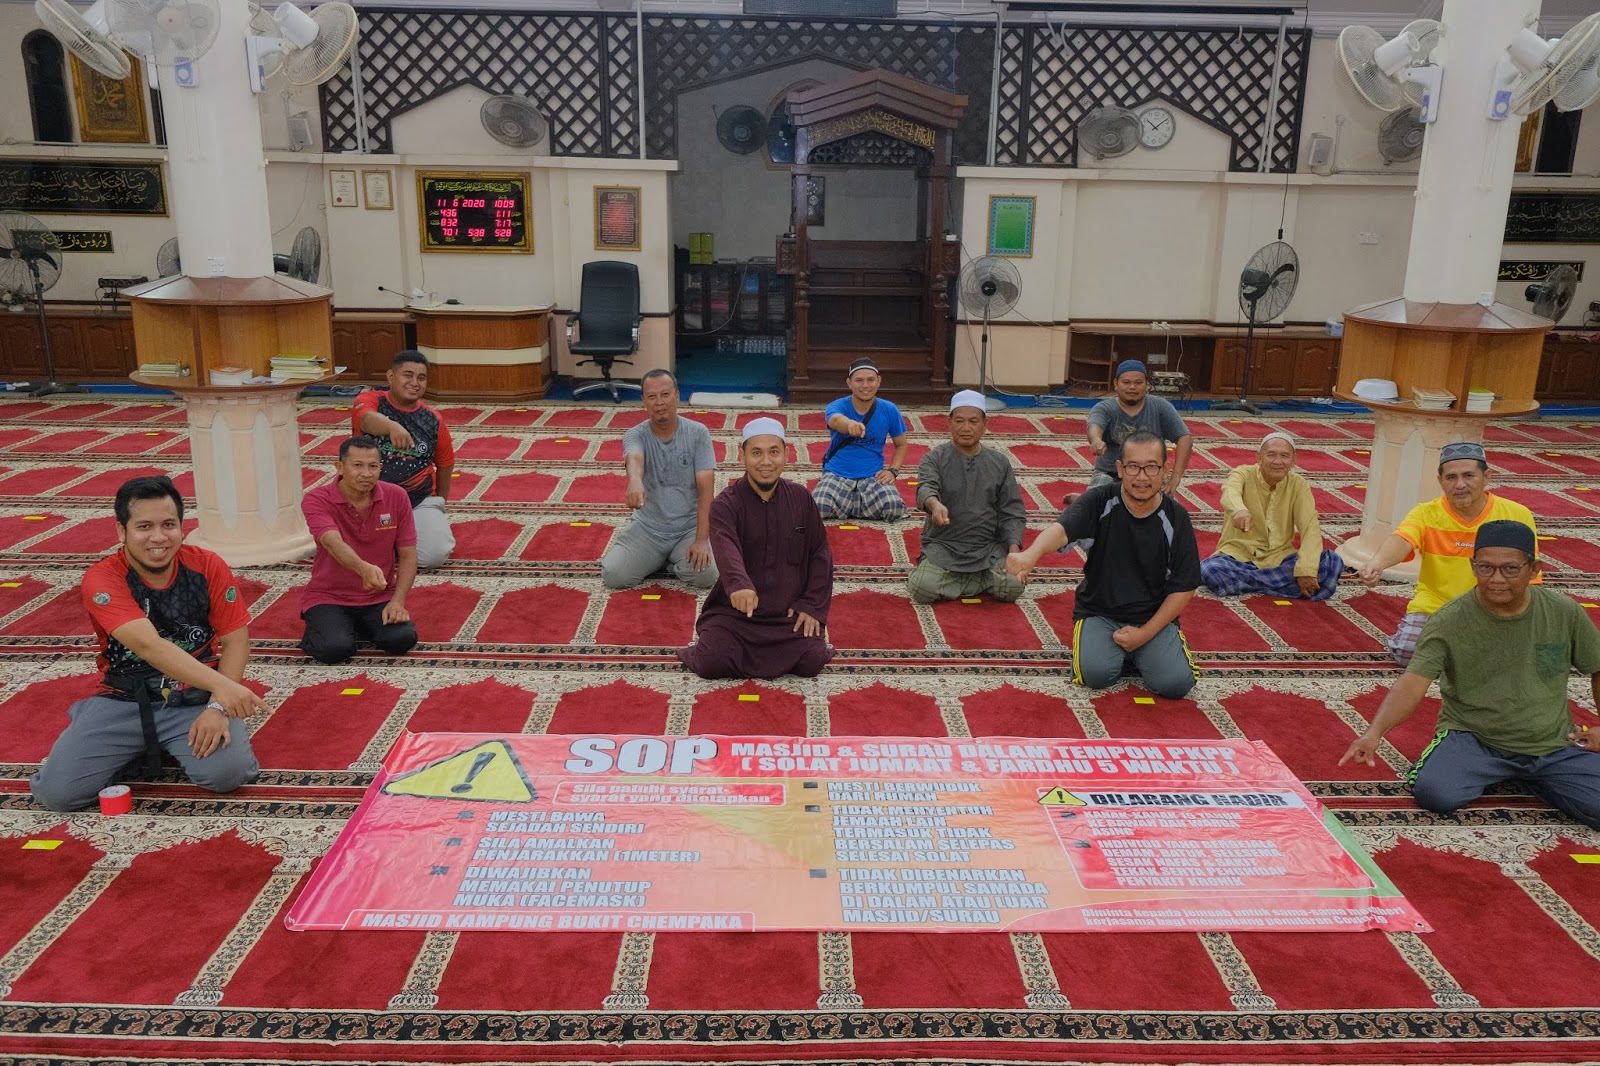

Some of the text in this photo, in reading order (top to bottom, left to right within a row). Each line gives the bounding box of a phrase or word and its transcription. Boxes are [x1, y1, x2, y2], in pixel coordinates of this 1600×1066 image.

[437, 198, 485, 208] 11 6 2020
[564, 737, 719, 775] SOP
[731, 742, 1236, 760] MASJID & SURAU DALAM TEMPOH PKPP
[758, 757, 843, 771] SOLAT
[848, 758, 953, 772] JUMAAT
[961, 759, 982, 772] &
[984, 758, 1094, 774] FARDHU
[1098, 759, 1119, 774] 5
[1119, 760, 1223, 775] WAKTU
[572, 784, 606, 793] Sila
[609, 784, 666, 795] patuhi
[826, 781, 982, 792] MESTI BERWUDUK
[569, 793, 770, 804] syarat yang ditetapkan
[827, 791, 938, 801] DARI RUMAH
[1088, 793, 1290, 807] DILARANG HADIR
[831, 804, 994, 816] TIDAK MENYENTUH
[1198, 811, 1243, 820] TAHUN
[488, 811, 606, 822] MESTI BAWA
[832, 815, 947, 827] JEMAAH LAIN
[485, 822, 646, 834] SEJADAH SENDIRI
[1087, 819, 1106, 828] KE
[1158, 819, 1187, 828] DAN
[1187, 819, 1241, 828] WARGA
[832, 827, 993, 838] TERMASUK TIDAK
[1091, 827, 1135, 836] ASING
[478, 837, 616, 849] SILA AMALKAN
[834, 838, 1016, 850] BERSALAM SELEPAS
[1162, 839, 1200, 849] YANG
[471, 849, 701, 862] PENJARAKKAN (1METER)
[835, 850, 972, 863] SELESAI SOLAT
[1106, 857, 1156, 867] SESAK
[1153, 857, 1201, 867] NAFAS
[464, 866, 593, 880] DIWAJIBKAN
[836, 868, 1027, 881] TIDAK DIBENARKAN
[1110, 866, 1159, 876] TEKAK
[1159, 866, 1206, 876] SERTA
[458, 880, 652, 894] MEMAKAI PENUTUP
[1115, 876, 1185, 886] PENYAKIT
[839, 881, 1050, 895] BERKUMPUL SAMADA
[452, 894, 647, 908] MUKA (FACEMASK)
[840, 895, 1049, 909] DI DALAM ATAU LUAR
[842, 909, 1002, 924] MASJID/SURAU
[1080, 908, 1133, 917] Diminta
[1132, 908, 1182, 917] kepada
[1232, 908, 1271, 917] untuk
[360, 913, 743, 930] MASJID KAMPUNG BUKIT CHEMPAKA
[1155, 917, 1187, 926] bagi
